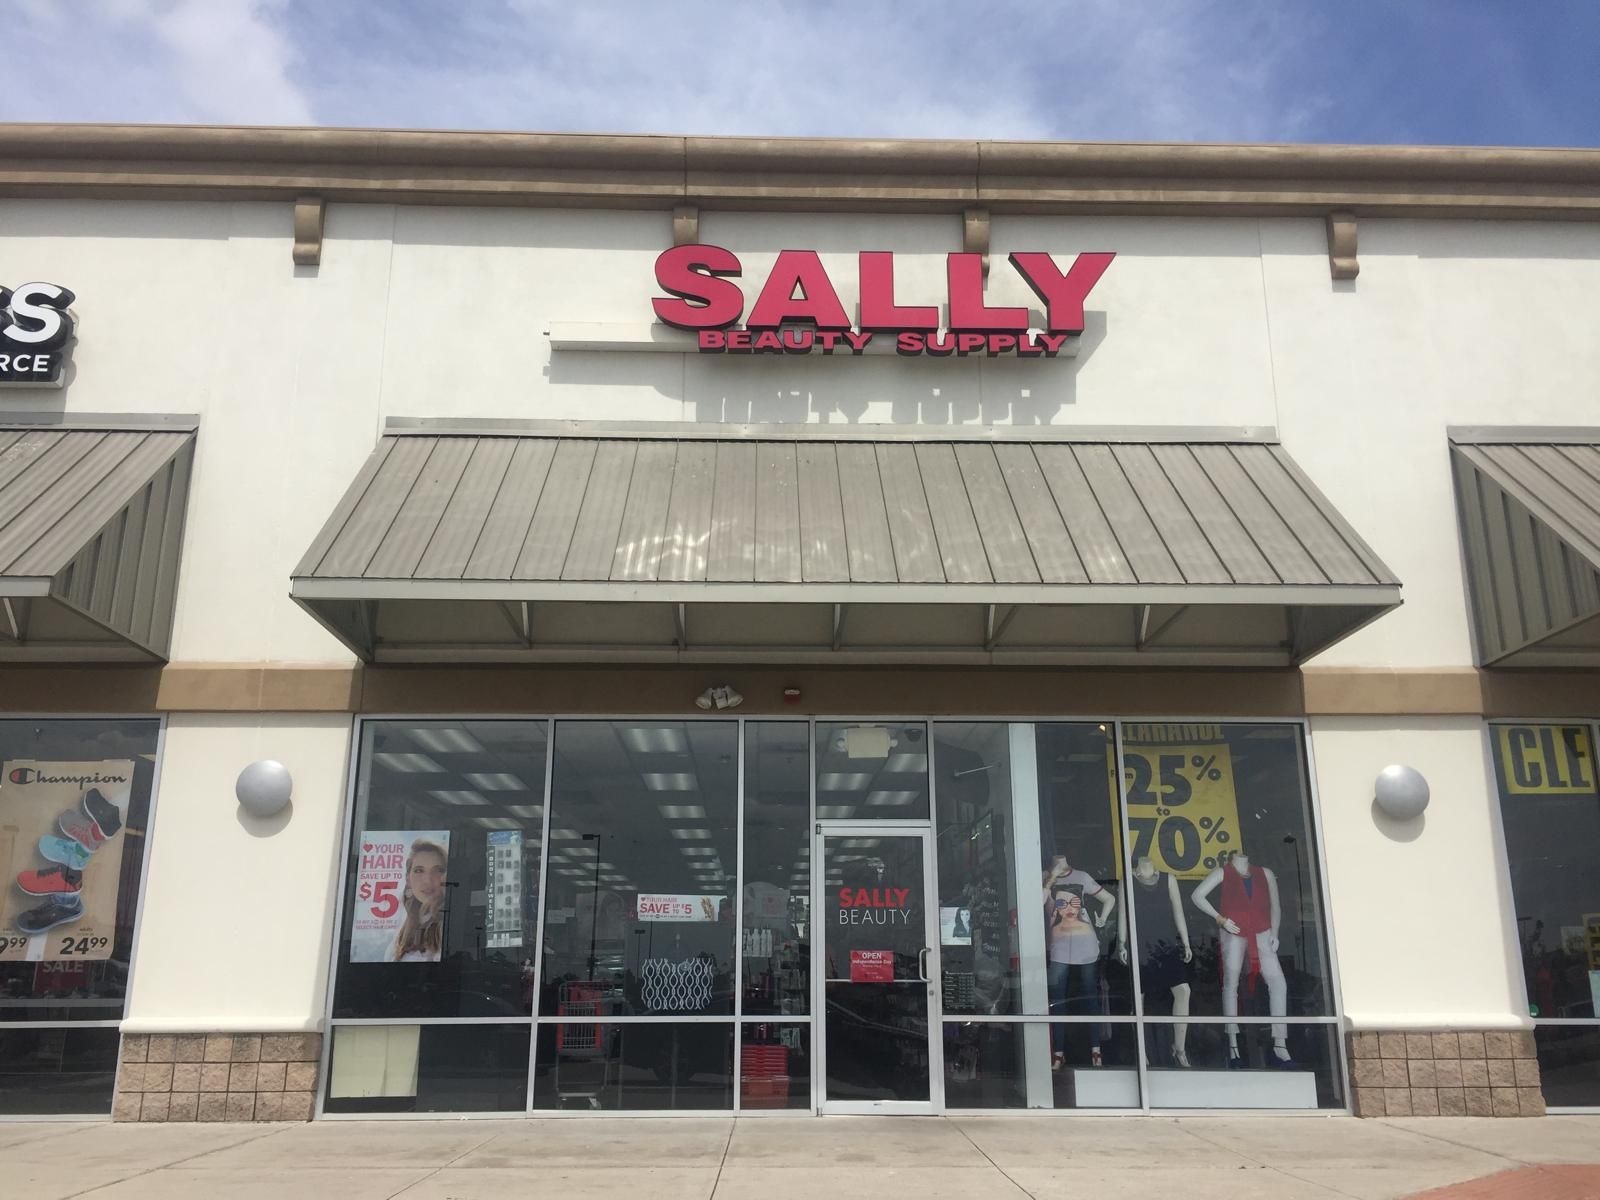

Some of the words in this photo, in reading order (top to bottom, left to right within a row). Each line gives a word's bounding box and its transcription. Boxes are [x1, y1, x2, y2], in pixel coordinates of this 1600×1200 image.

[651, 244, 1117, 331] SALLY
[0, 282, 63, 343] S
[699, 329, 873, 354] BEAUTY
[896, 332, 1068, 357] SUPPLY
[9, 768, 127, 790] Champion
[1122, 753, 1222, 806] 25%
[1156, 807, 1171, 816] to
[374, 844, 404, 853] YOUR
[1127, 816, 1230, 872] 70%
[362, 855, 404, 869] HAIR
[359, 881, 399, 918] $5
[839, 888, 910, 908] SALLY
[640, 903, 670, 914] SAVE
[682, 903, 692, 915] $5
[839, 909, 911, 925] BEAUTY
[862, 952, 882, 960] OPEN
[42, 960, 84, 973] SALE
